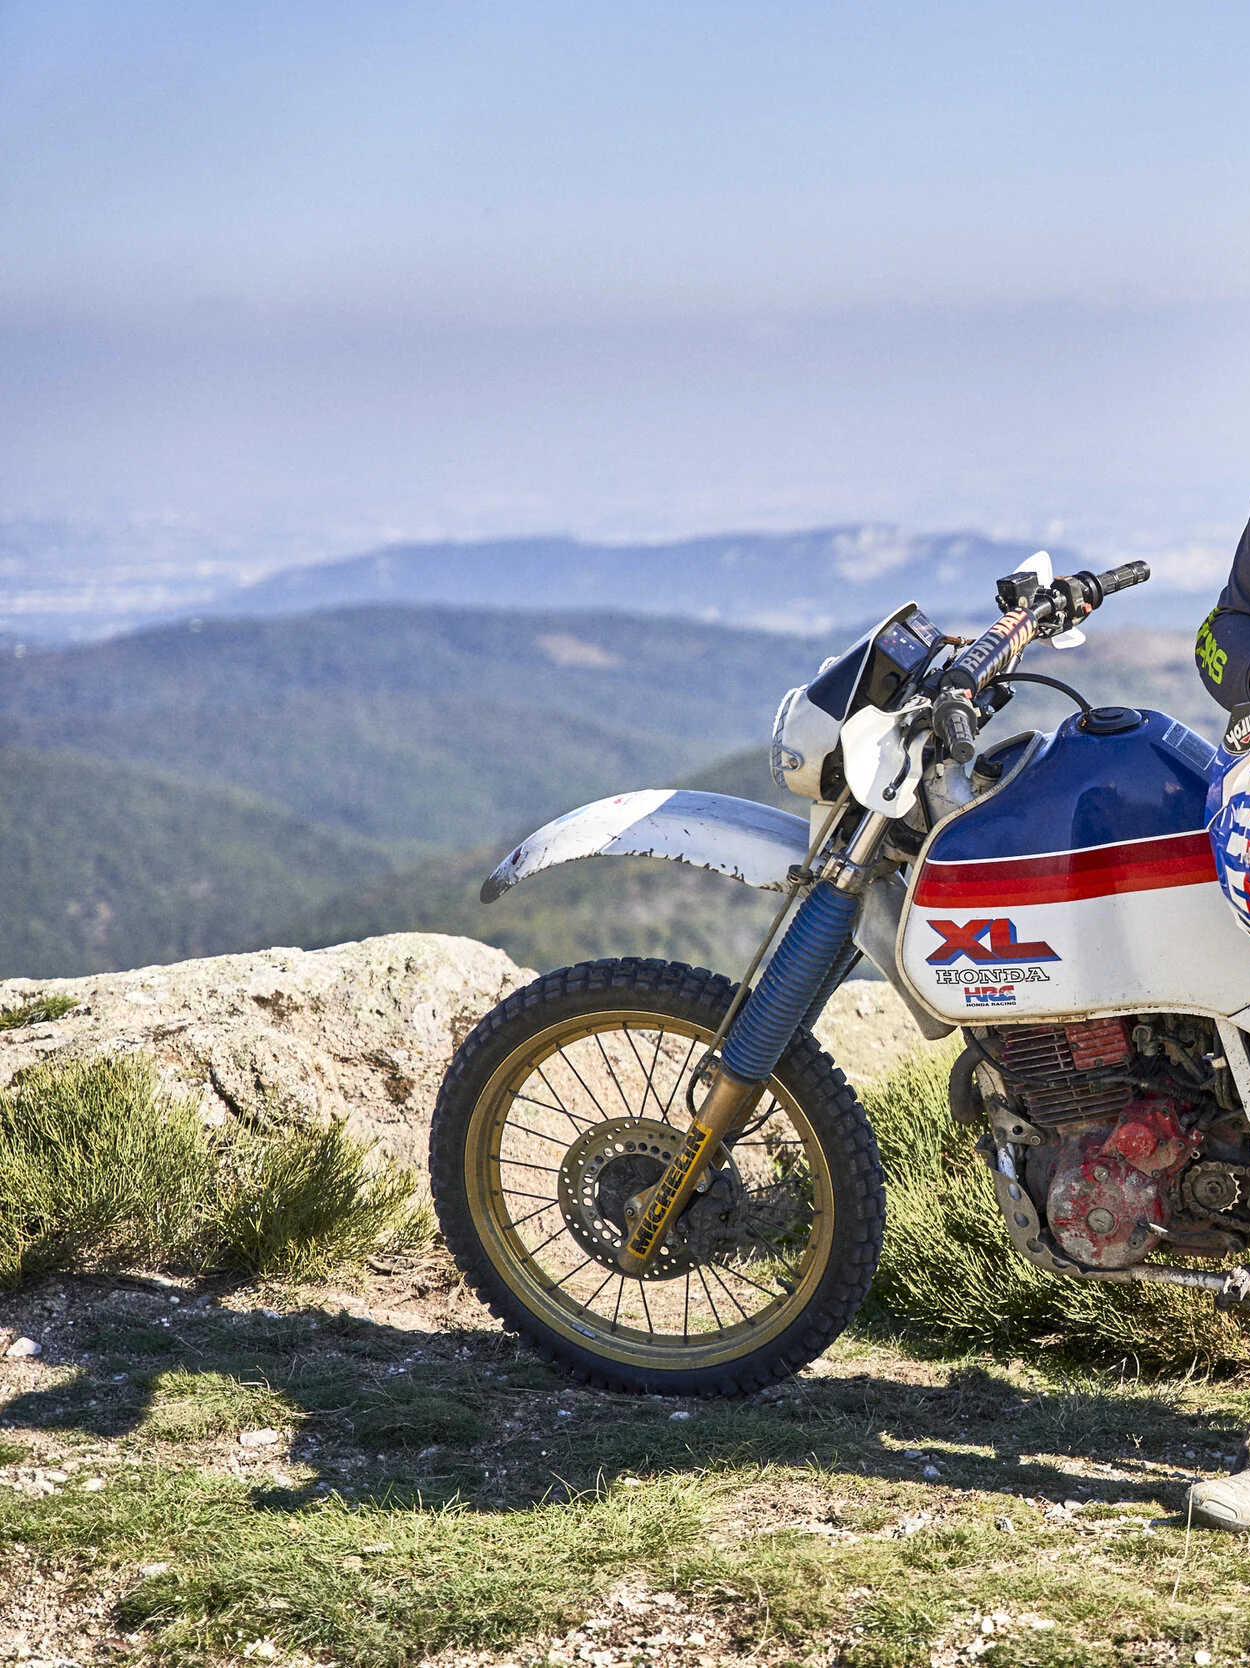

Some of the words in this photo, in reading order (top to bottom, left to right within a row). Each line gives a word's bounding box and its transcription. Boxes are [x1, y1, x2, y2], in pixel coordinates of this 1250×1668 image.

[959, 610, 1028, 673] RENTHAL
[926, 918, 1063, 966] XL
[936, 967, 1050, 985] HONDA
[964, 985, 1016, 1003] HRC
[630, 1127, 708, 1255] MICHELIN
